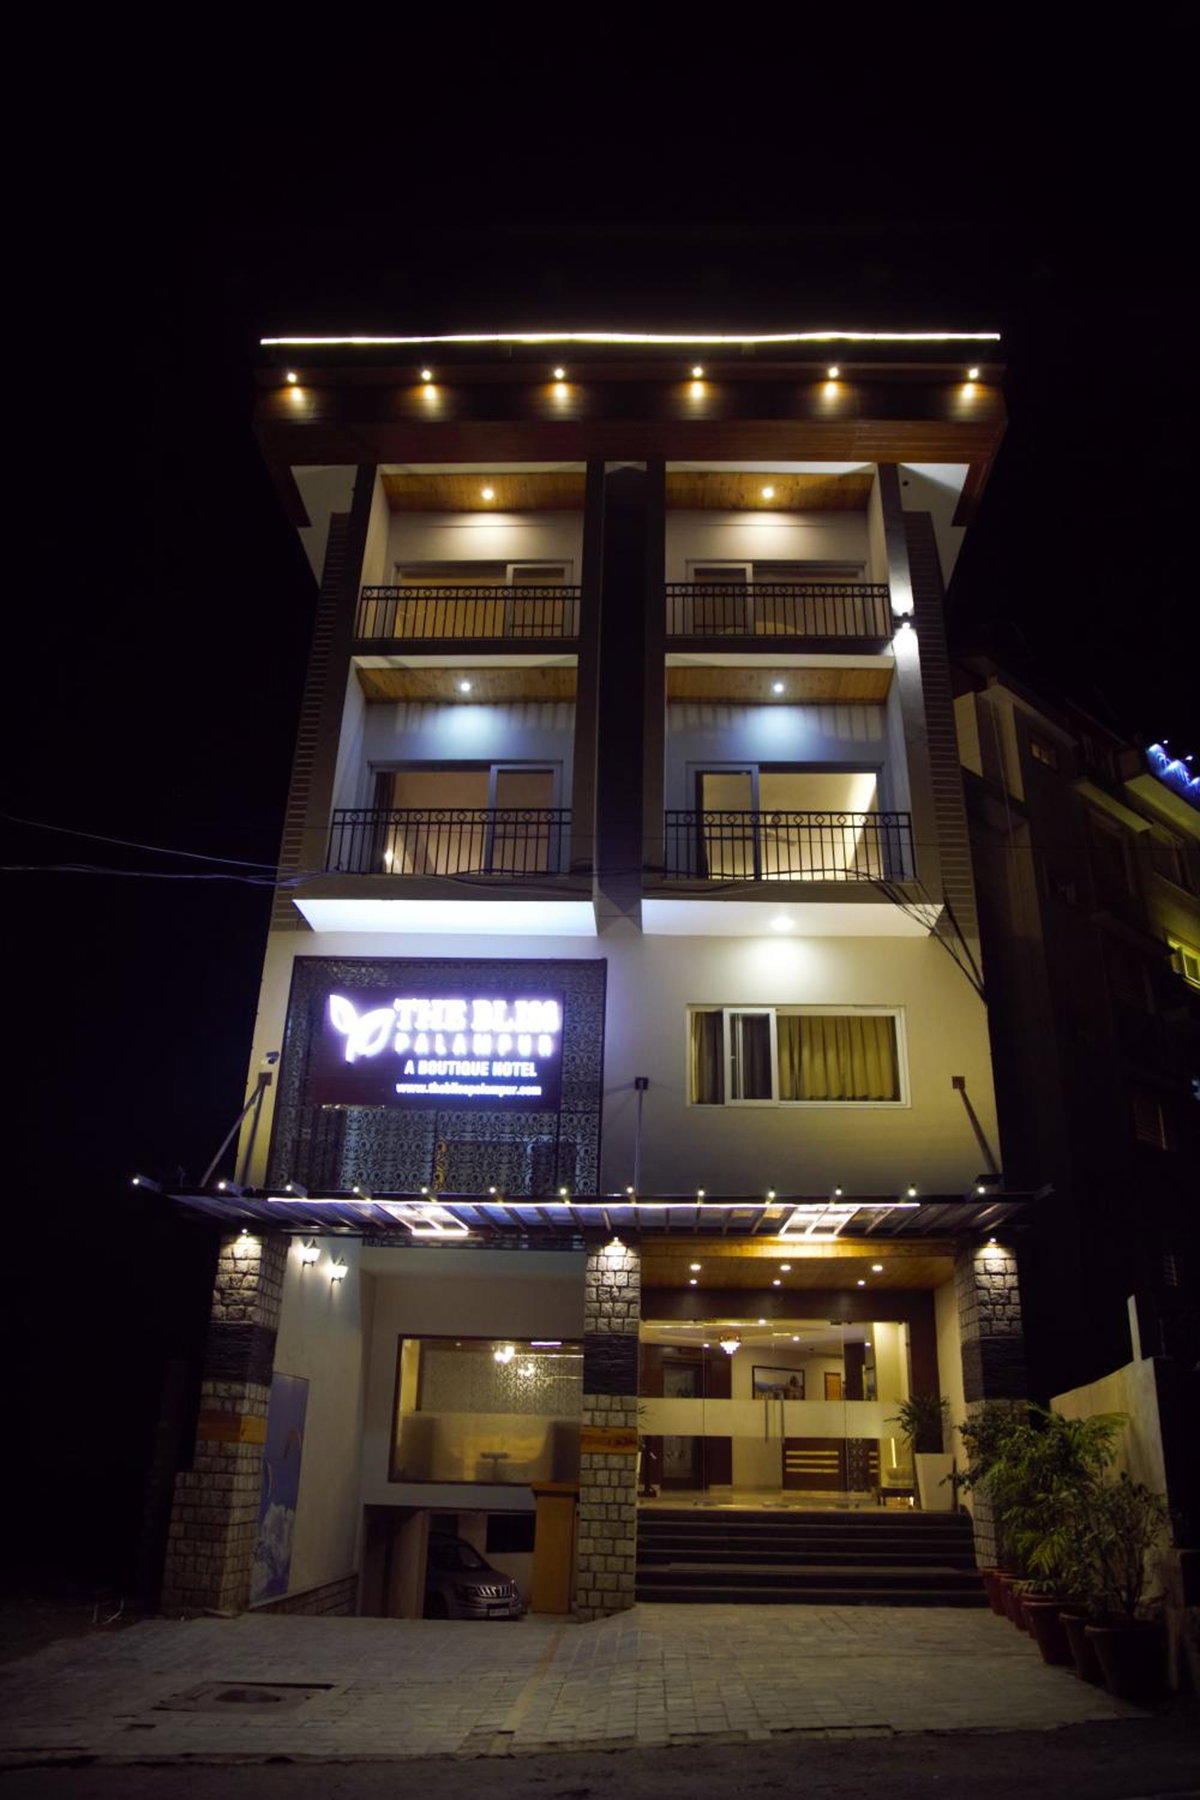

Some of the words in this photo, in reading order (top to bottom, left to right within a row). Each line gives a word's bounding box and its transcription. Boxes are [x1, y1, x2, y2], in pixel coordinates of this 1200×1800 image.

[394, 999, 467, 1031] THE
[395, 1033, 552, 1056] PALAMPUR
[404, 1060, 414, 1074] A
[418, 1060, 489, 1076] BOUTIQUE
[492, 1061, 537, 1077] HOTEL
